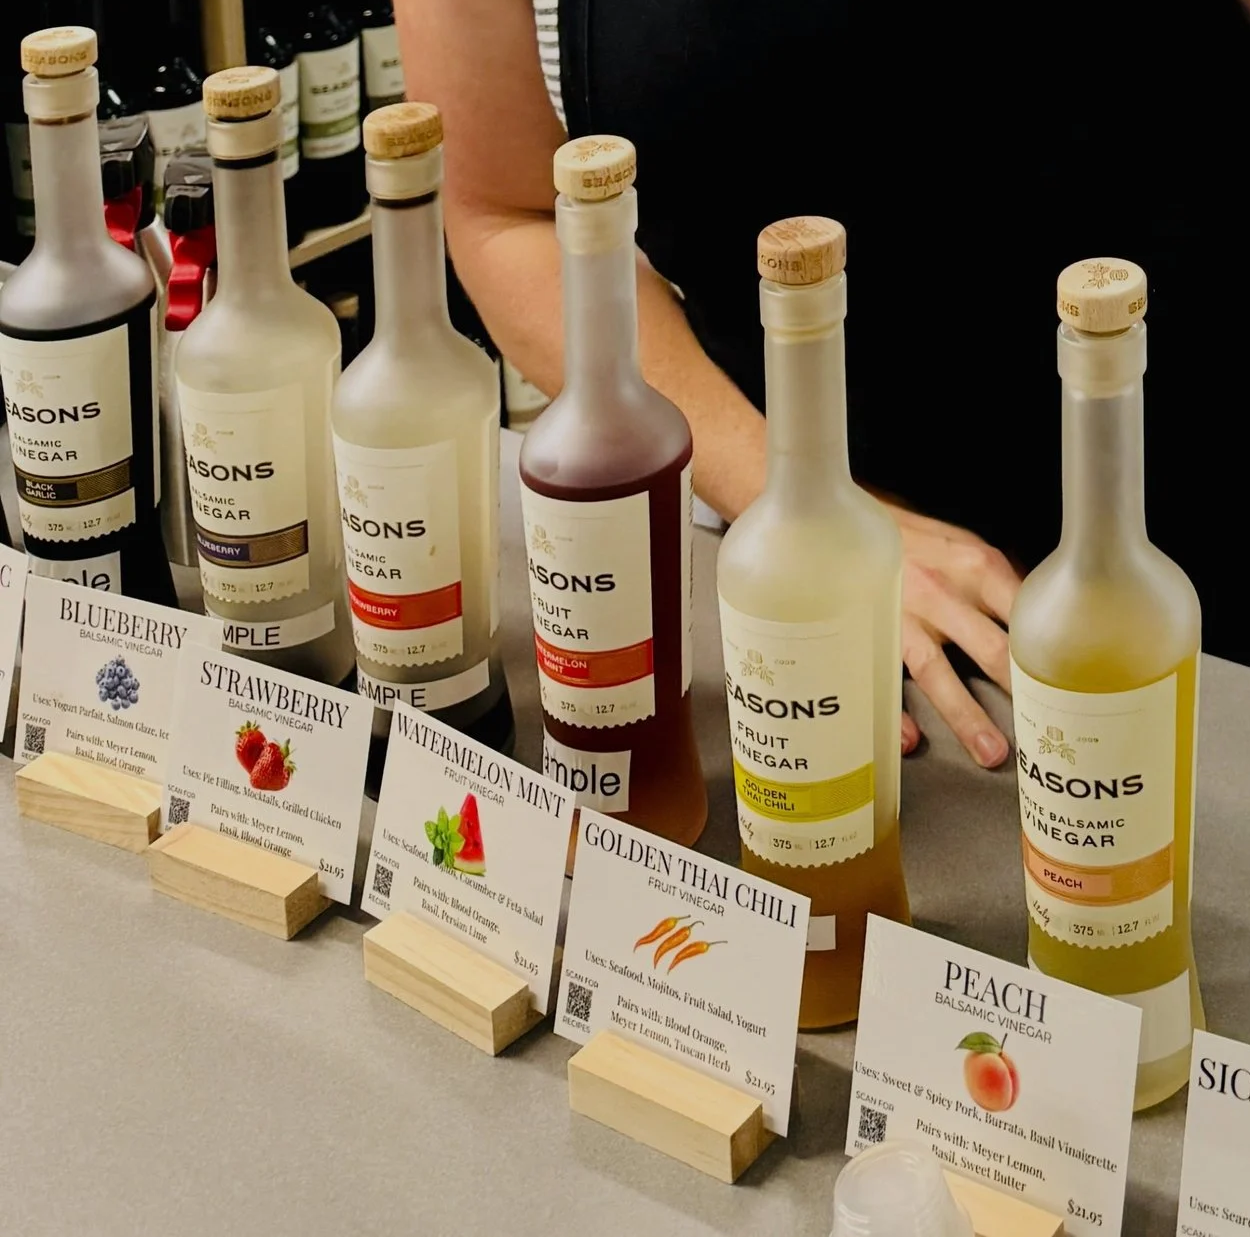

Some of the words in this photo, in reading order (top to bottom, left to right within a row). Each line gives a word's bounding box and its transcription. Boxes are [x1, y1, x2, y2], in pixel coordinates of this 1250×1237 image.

[5, 397, 101, 424] EASONS
[189, 454, 275, 481] ASONS
[343, 508, 426, 538] ASONS
[529, 557, 616, 593] ASONS
[60, 596, 188, 650] BLUEBERRY
[222, 625, 281, 646] MPLE
[79, 628, 124, 650] BALSAMIC
[125, 639, 163, 659] VINEGAR
[200, 659, 350, 730] STRAWBERRY
[358, 683, 427, 708] AMPLE
[726, 672, 840, 720] EASONS
[228, 697, 272, 723] BALSAMIC
[274, 711, 313, 734] VINEGAR
[736, 720, 789, 750] FRUIT
[396, 711, 514, 793] WATERMELON
[516, 775, 566, 819] MINT
[545, 745, 621, 797] mple
[1017, 748, 1144, 800] EASONS
[444, 765, 468, 786] FRUIT
[468, 777, 505, 808] VINEGAR
[742, 785, 762, 804] THAI
[764, 796, 795, 811] CHILI
[745, 778, 787, 801] GOLDEN
[309, 805, 342, 830] Chicken
[1024, 805, 1115, 848] VINEGAR
[1049, 811, 1126, 830] BALSAMIC
[773, 837, 792, 850] 375
[815, 837, 836, 850] 12.7
[318, 857, 345, 880] $21.95
[459, 870, 497, 900] Cucumber
[584, 820, 672, 877] GOLDEN
[676, 856, 729, 901] THAI
[734, 881, 797, 929] CHILI
[1043, 867, 1083, 890] PEACH
[647, 875, 678, 898] FRUIT
[678, 885, 725, 917] VINEGAR
[1073, 923, 1094, 937] 375
[1117, 920, 1139, 935] 12.7
[608, 957, 645, 987] Seafood,
[683, 990, 706, 1011] Fruit
[735, 1011, 768, 1040] Yogurt
[942, 959, 1048, 1024] PEACH
[616, 994, 639, 1016] Pairs
[664, 1014, 692, 1038] Blood
[934, 990, 996, 1024] BALSAMIC
[996, 1013, 1052, 1045] VINEGAR
[609, 1009, 638, 1036] Meyer
[673, 1036, 706, 1064] Tuscan
[706, 1049, 732, 1074] Herb
[744, 1069, 777, 1097] $21.95
[854, 1060, 881, 1083] Uses:
[881, 1070, 912, 1095] Sweet
[913, 1083, 925, 1098] &
[925, 1087, 953, 1111] Spicy
[954, 1098, 982, 1122] Pork,
[984, 1110, 1027, 1140] Burrata,
[1029, 1128, 1056, 1149] Basil
[1056, 1136, 1118, 1175] Vinaigrette
[915, 1117, 942, 1141] Pairs
[943, 1128, 970, 1152] with:
[971, 1139, 1005, 1166] Meyer
[1006, 1152, 1047, 1182] Lemon,
[959, 1155, 991, 1180] Sweet
[992, 1167, 1027, 1193] Butter
[1066, 1198, 1104, 1227] $21.95
[1188, 1195, 1220, 1218] Uses:
